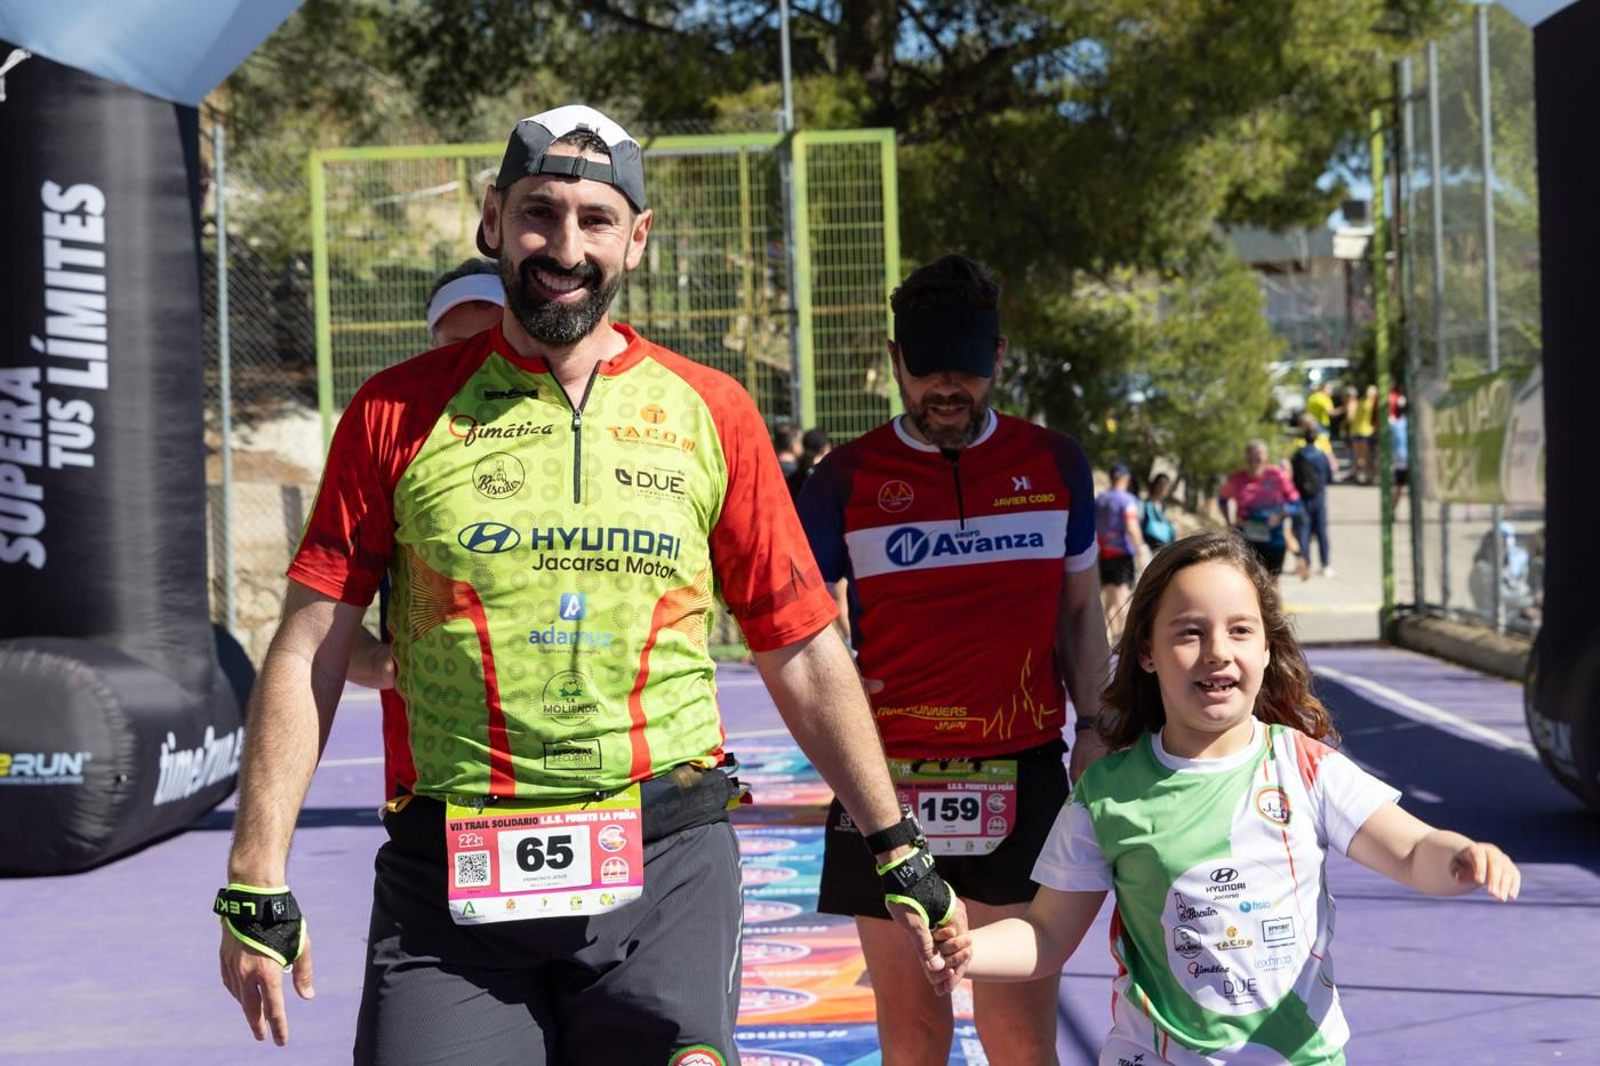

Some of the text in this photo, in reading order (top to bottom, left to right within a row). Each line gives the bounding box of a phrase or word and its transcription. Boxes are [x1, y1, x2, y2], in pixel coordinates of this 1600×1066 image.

[31, 180, 109, 469] TUS LÍMITES
[0, 366, 46, 570] SUPERA
[637, 470, 685, 496] DUE
[993, 493, 1056, 507] JAVIER COBO
[532, 526, 681, 561] HYUNDAI
[932, 531, 1044, 557] Avanza
[532, 553, 677, 579] Jacarsa Motor
[529, 626, 613, 647] adamuz
[543, 703, 600, 714] MOLIENDA
[450, 822, 463, 832] VII
[464, 819, 490, 831] TRAIL
[491, 816, 539, 828] SOLIDARIO
[565, 812, 598, 823] FUENTE
[599, 811, 611, 821] LA
[612, 808, 637, 820] PEÑA
[921, 796, 980, 822] 159
[516, 834, 574, 873] 65
[1206, 882, 1247, 893] HYUNDAI
[216, 896, 256, 916] LEKI
[1223, 977, 1258, 995] DUE
